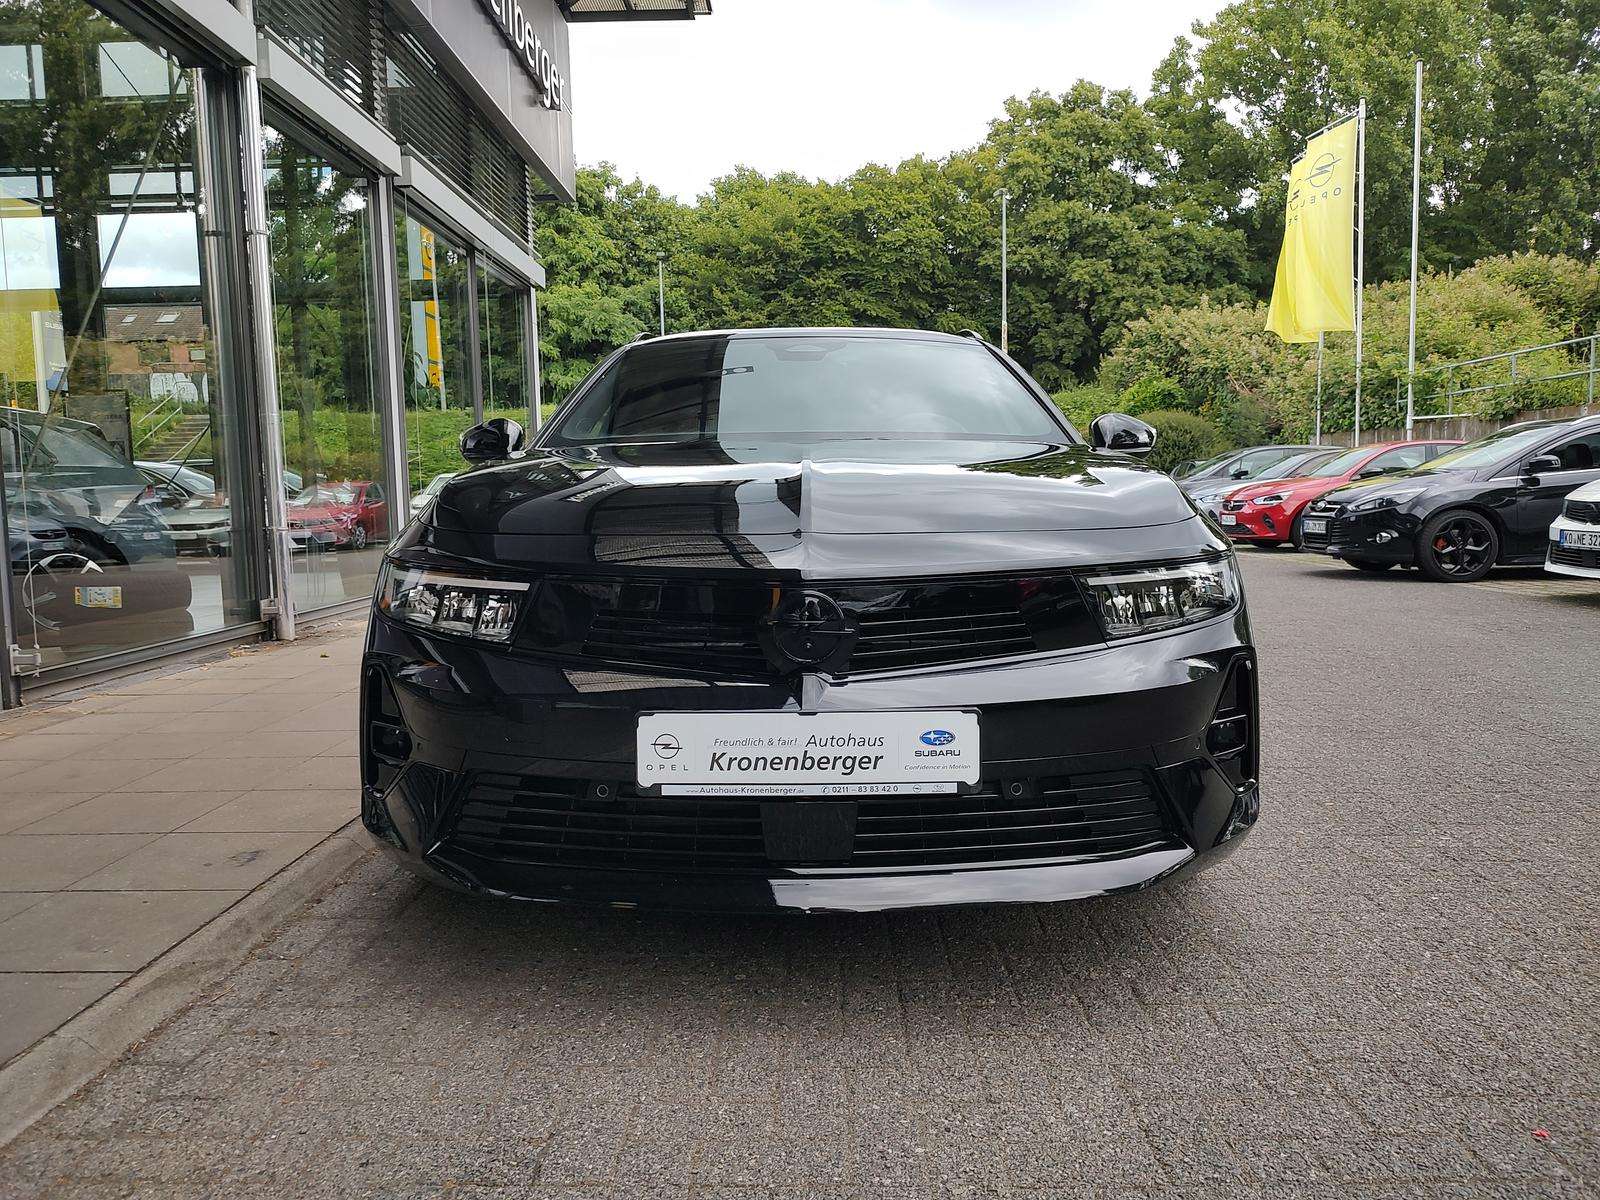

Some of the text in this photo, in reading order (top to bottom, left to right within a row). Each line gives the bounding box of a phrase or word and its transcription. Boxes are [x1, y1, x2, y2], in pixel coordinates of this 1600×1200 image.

[713, 733, 885, 748] Freundlich & fair! Autohaus
[914, 749, 961, 757] SUBARU
[646, 763, 689, 771] OPEL
[709, 750, 884, 776] Kronenberger
[904, 763, 941, 771] Confidence
[857, 785, 867, 793] 83
[869, 785, 879, 793] 83
[881, 785, 891, 793] 42
